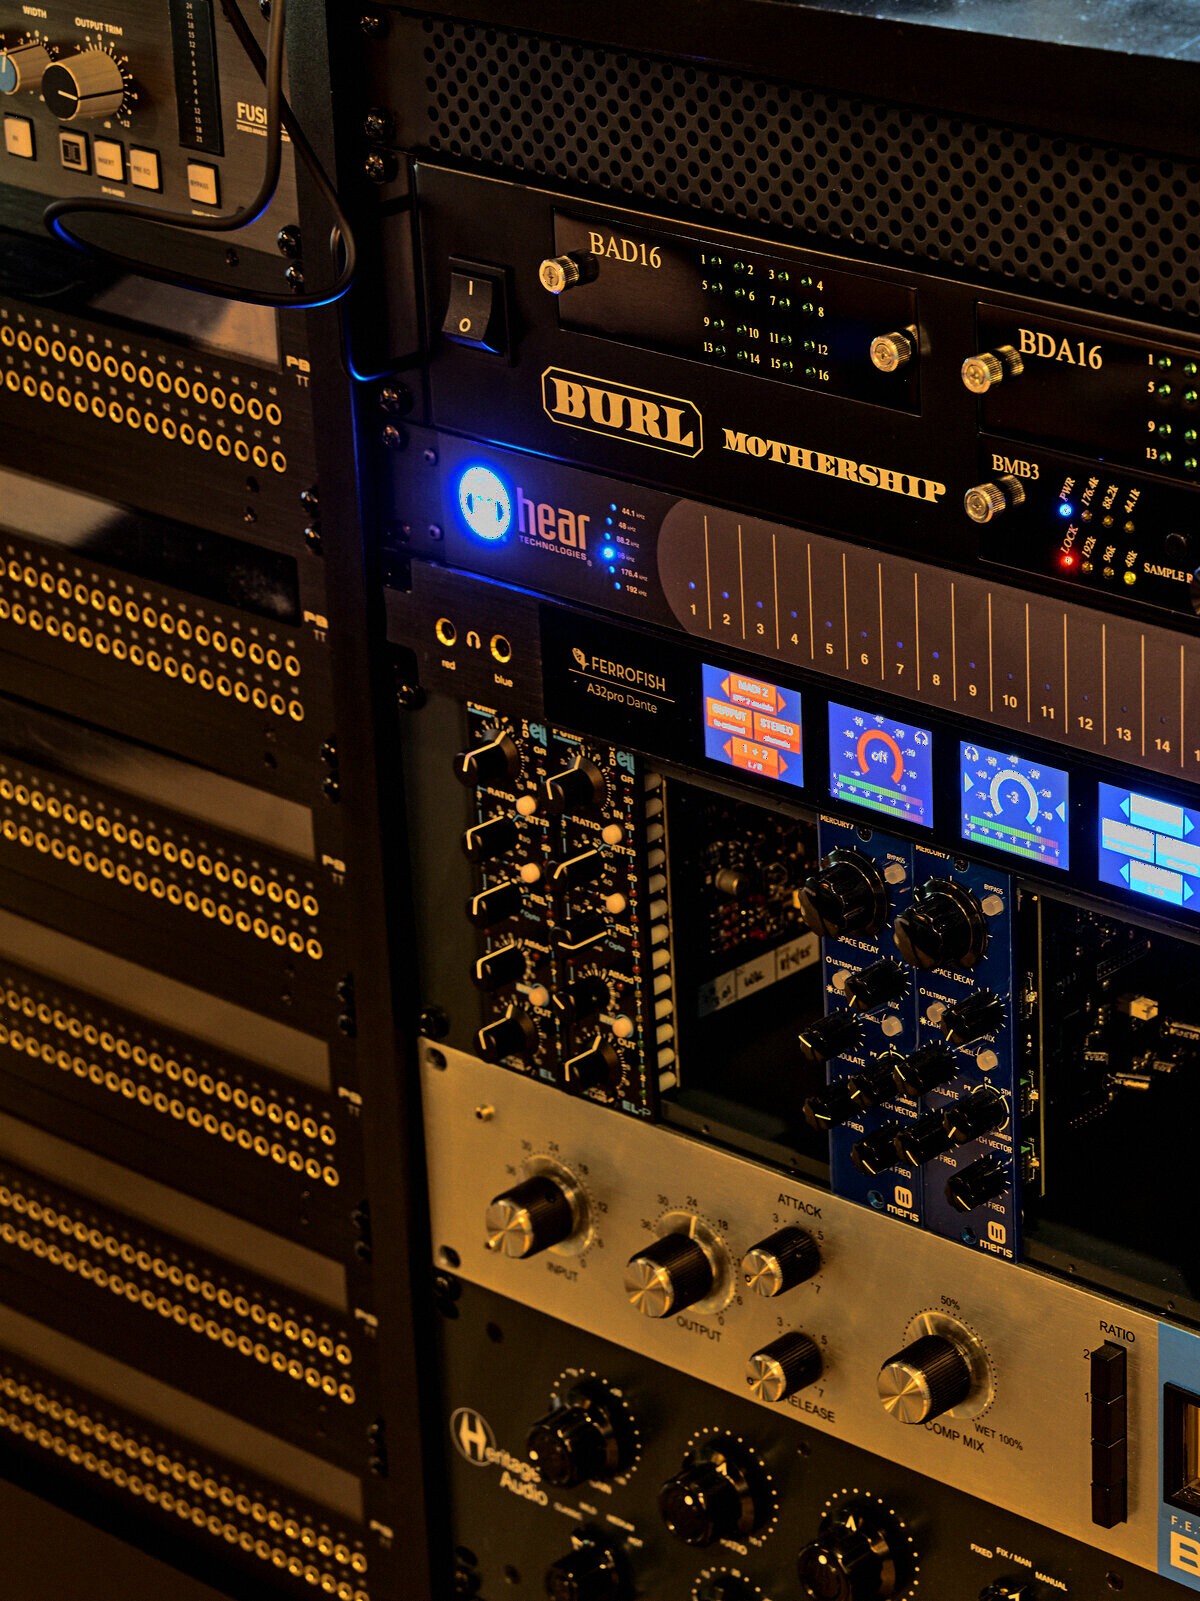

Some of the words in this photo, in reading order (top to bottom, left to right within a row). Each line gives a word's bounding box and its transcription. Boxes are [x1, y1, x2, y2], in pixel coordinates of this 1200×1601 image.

[23, 5, 47, 18] WIDTH
[75, 17, 104, 31] OUTPUT
[105, 23, 123, 36] TRIM
[237, 101, 267, 125] FUSI
[588, 232, 662, 269] BAD16
[1018, 328, 1103, 370] BDA16
[550, 377, 694, 448] BURL
[722, 428, 946, 503] MOTHERSHIP
[1146, 447, 1157, 460] 13
[992, 454, 1040, 480] BMB3
[1059, 477, 1076, 502] PWR
[517, 487, 590, 550] hear
[519, 535, 587, 560] TECHNOLOGIES
[1060, 524, 1078, 554] LOCK
[1144, 562, 1183, 582] SAMPLE
[441, 659, 456, 671] red
[494, 673, 514, 688] blue
[591, 656, 666, 692] FERROFISH
[690, 604, 697, 615] 1
[723, 614, 731, 625] 2
[757, 623, 765, 635] 3
[791, 633, 799, 645] 4
[826, 643, 833, 655] 5
[861, 653, 869, 665] 6
[896, 663, 904, 675] 7
[932, 674, 941, 686] 8
[969, 685, 977, 697] 9
[1002, 694, 1017, 708] 10
[1041, 705, 1055, 720] 11
[1078, 716, 1093, 731] 12
[1116, 727, 1132, 742] 13
[1155, 738, 1171, 753] 14
[586, 682, 624, 703] A32pro
[626, 694, 658, 714] Dante
[858, 941, 879, 954] DECAY
[953, 972, 975, 986] DECAY
[777, 1193, 823, 1220] ATTACK
[887, 1201, 920, 1223] meris
[979, 1239, 1013, 1259] meris
[546, 1261, 579, 1283] INPUT
[940, 1295, 960, 1311] 50%
[676, 1315, 722, 1343] OUTPUT
[1099, 1320, 1136, 1343] RATIO
[924, 1420, 960, 1441] COMP
[962, 1434, 985, 1453] MIX
[974, 1422, 997, 1439] WET
[999, 1433, 1024, 1451] 100%
[500, 1471, 548, 1506] Audio
[970, 1543, 993, 1559] FIXED
[1035, 1571, 1068, 1591] MANUAL
